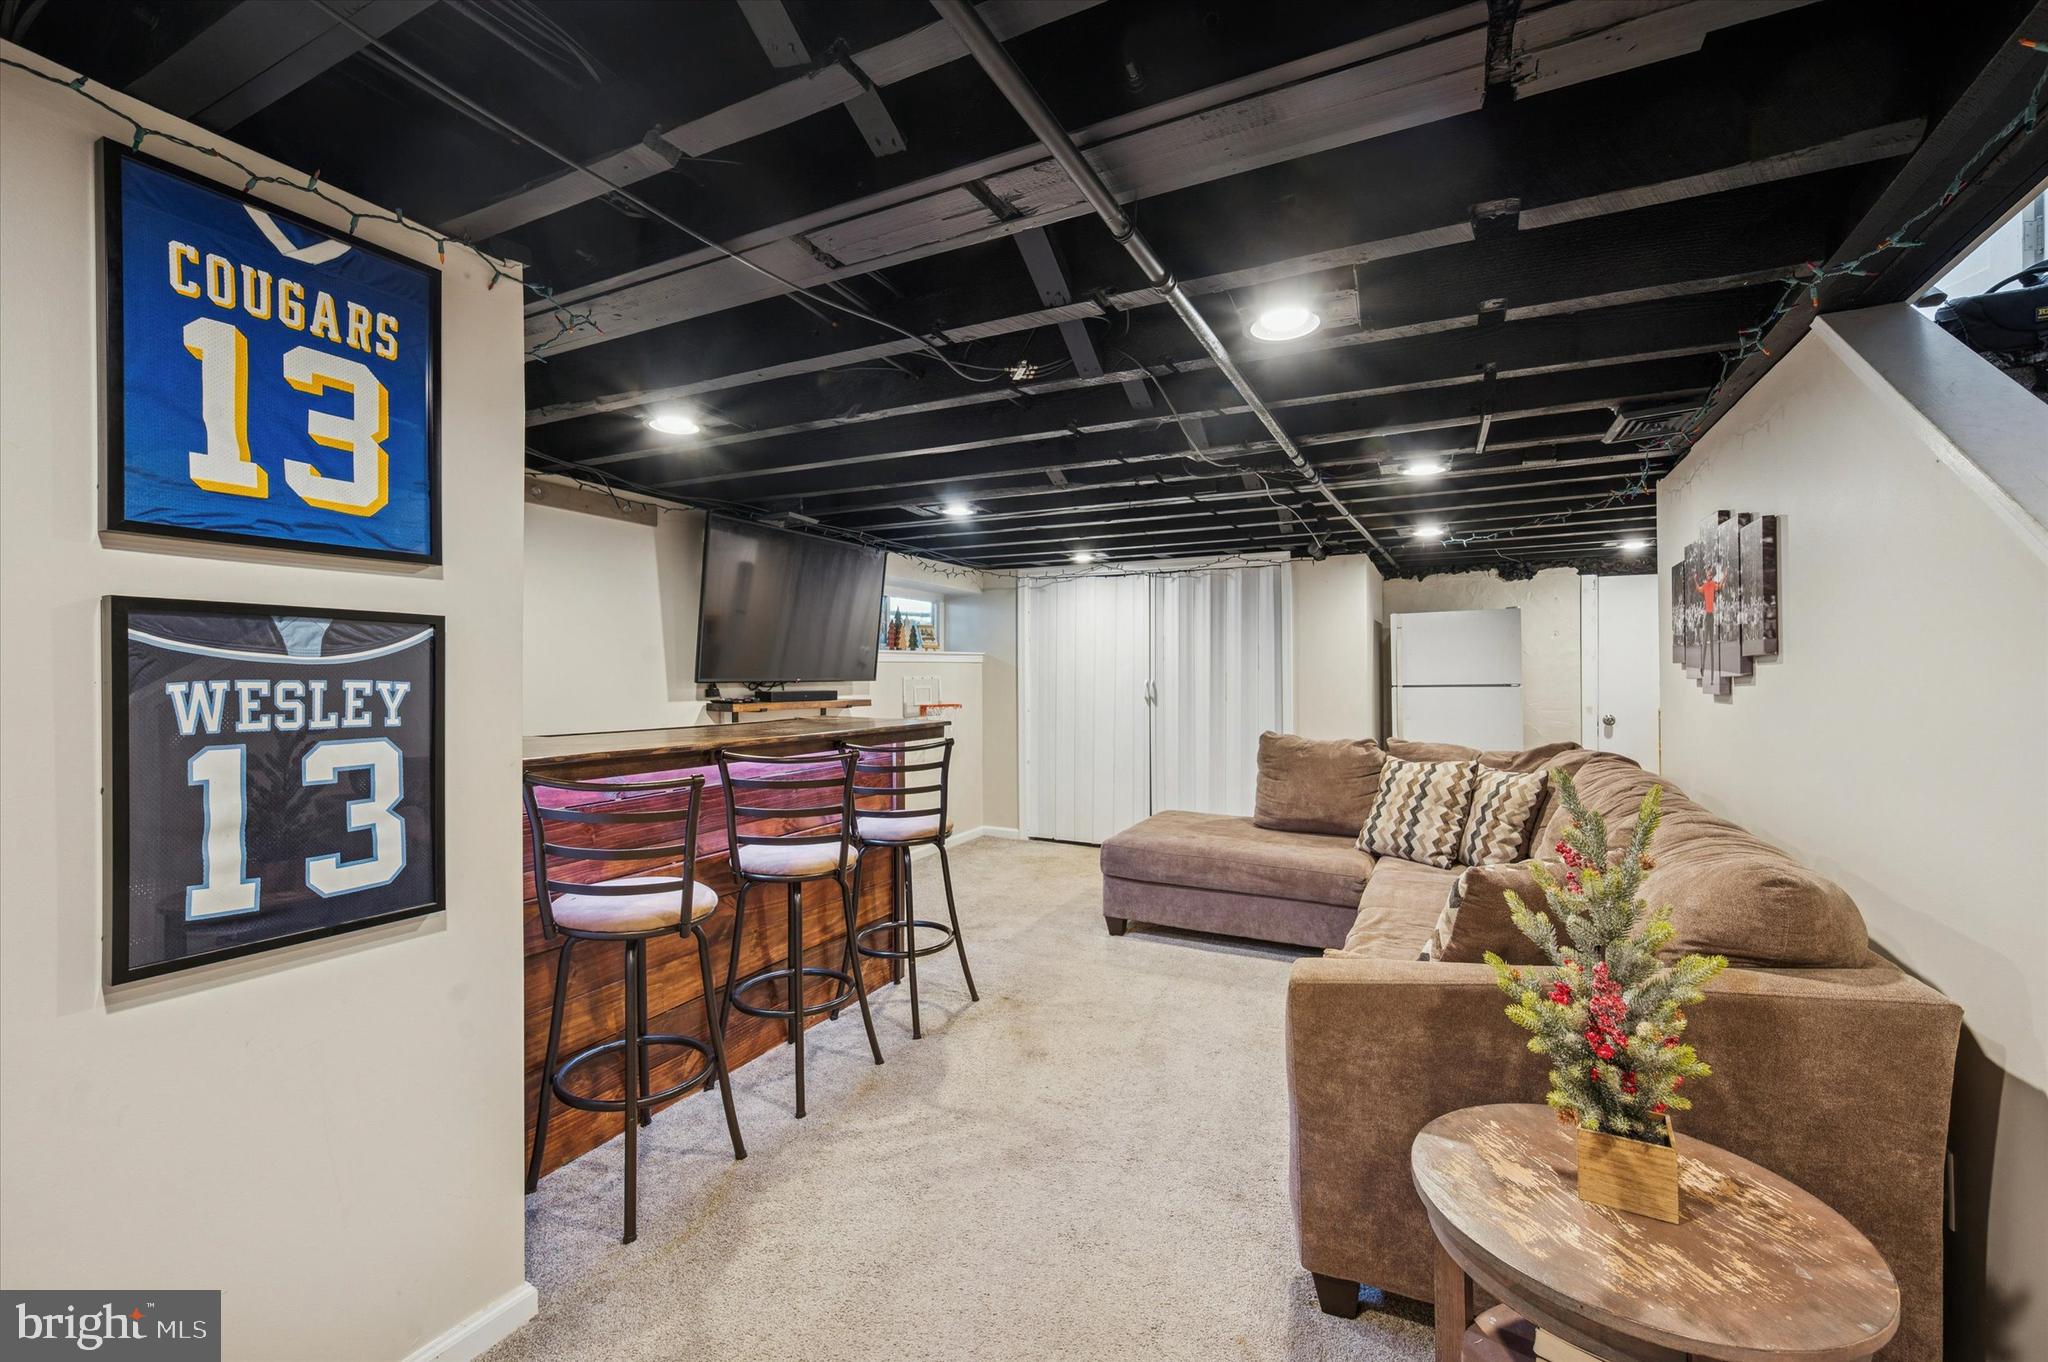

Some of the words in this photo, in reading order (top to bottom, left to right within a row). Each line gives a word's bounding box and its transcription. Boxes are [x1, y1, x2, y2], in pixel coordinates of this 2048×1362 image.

[168, 240, 399, 361] COUGARS
[182, 316, 390, 518] 13
[165, 679, 411, 736] WESLEY
[185, 737, 407, 922] 13
